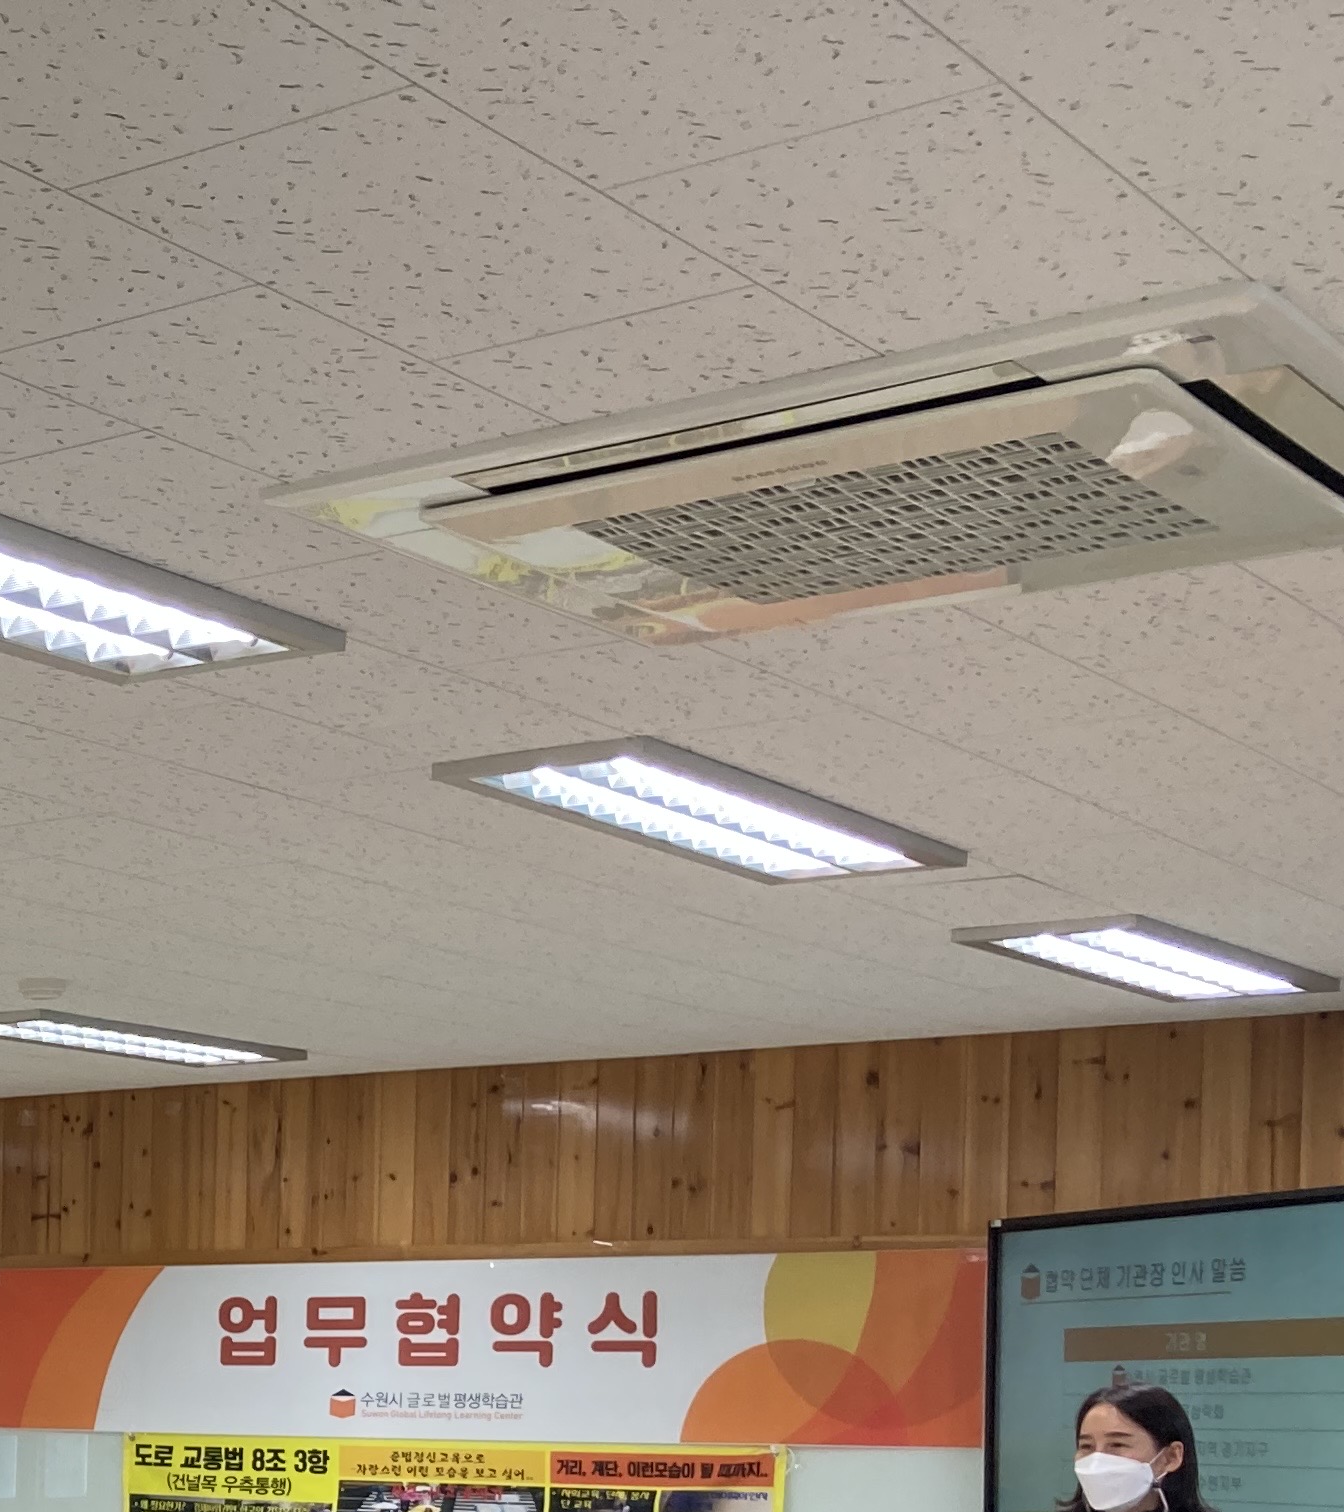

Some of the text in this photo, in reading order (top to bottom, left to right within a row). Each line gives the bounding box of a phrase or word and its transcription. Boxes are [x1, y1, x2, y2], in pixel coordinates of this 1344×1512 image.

[1116, 1263, 1164, 1289] 기관장
[218, 1291, 658, 1368] 업무협약식
[360, 1391, 403, 1408] 수원시
[134, 1443, 330, 1475] 도로 교통법 8조 3항
[166, 1472, 292, 1497] (건널목 우측통행)
